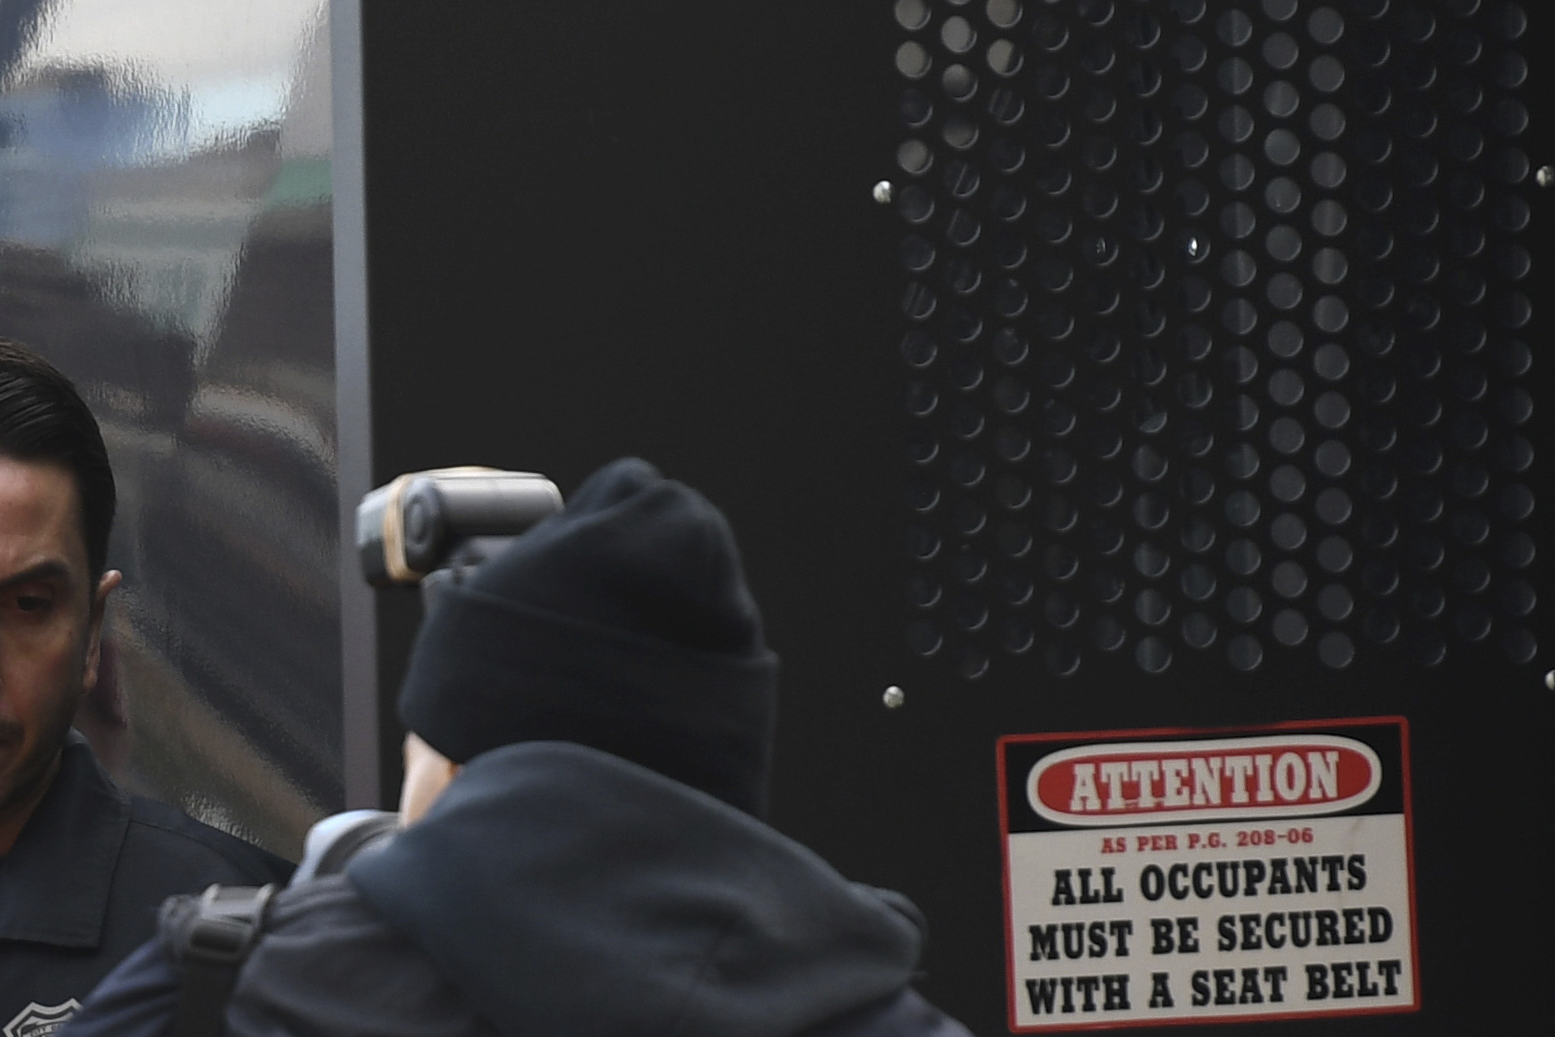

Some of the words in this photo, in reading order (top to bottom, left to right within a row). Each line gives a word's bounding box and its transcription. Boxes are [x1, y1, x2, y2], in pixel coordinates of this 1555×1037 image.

[1070, 751, 1340, 811] ATTENTION
[1101, 836, 1127, 853] AS
[1137, 834, 1178, 852] PER
[1188, 832, 1227, 850] P.G.
[1237, 828, 1314, 847] 208-06
[1051, 867, 1124, 906] ALL
[1140, 854, 1367, 902] OCCUPANTS
[1029, 920, 1133, 961] MUST
[1150, 917, 1200, 955] BE
[1217, 906, 1394, 952] SECURED
[1025, 974, 1131, 1015] WITH
[1148, 972, 1175, 1009] A
[1191, 966, 1288, 1007] SEAT
[1305, 960, 1402, 1001] BELT
